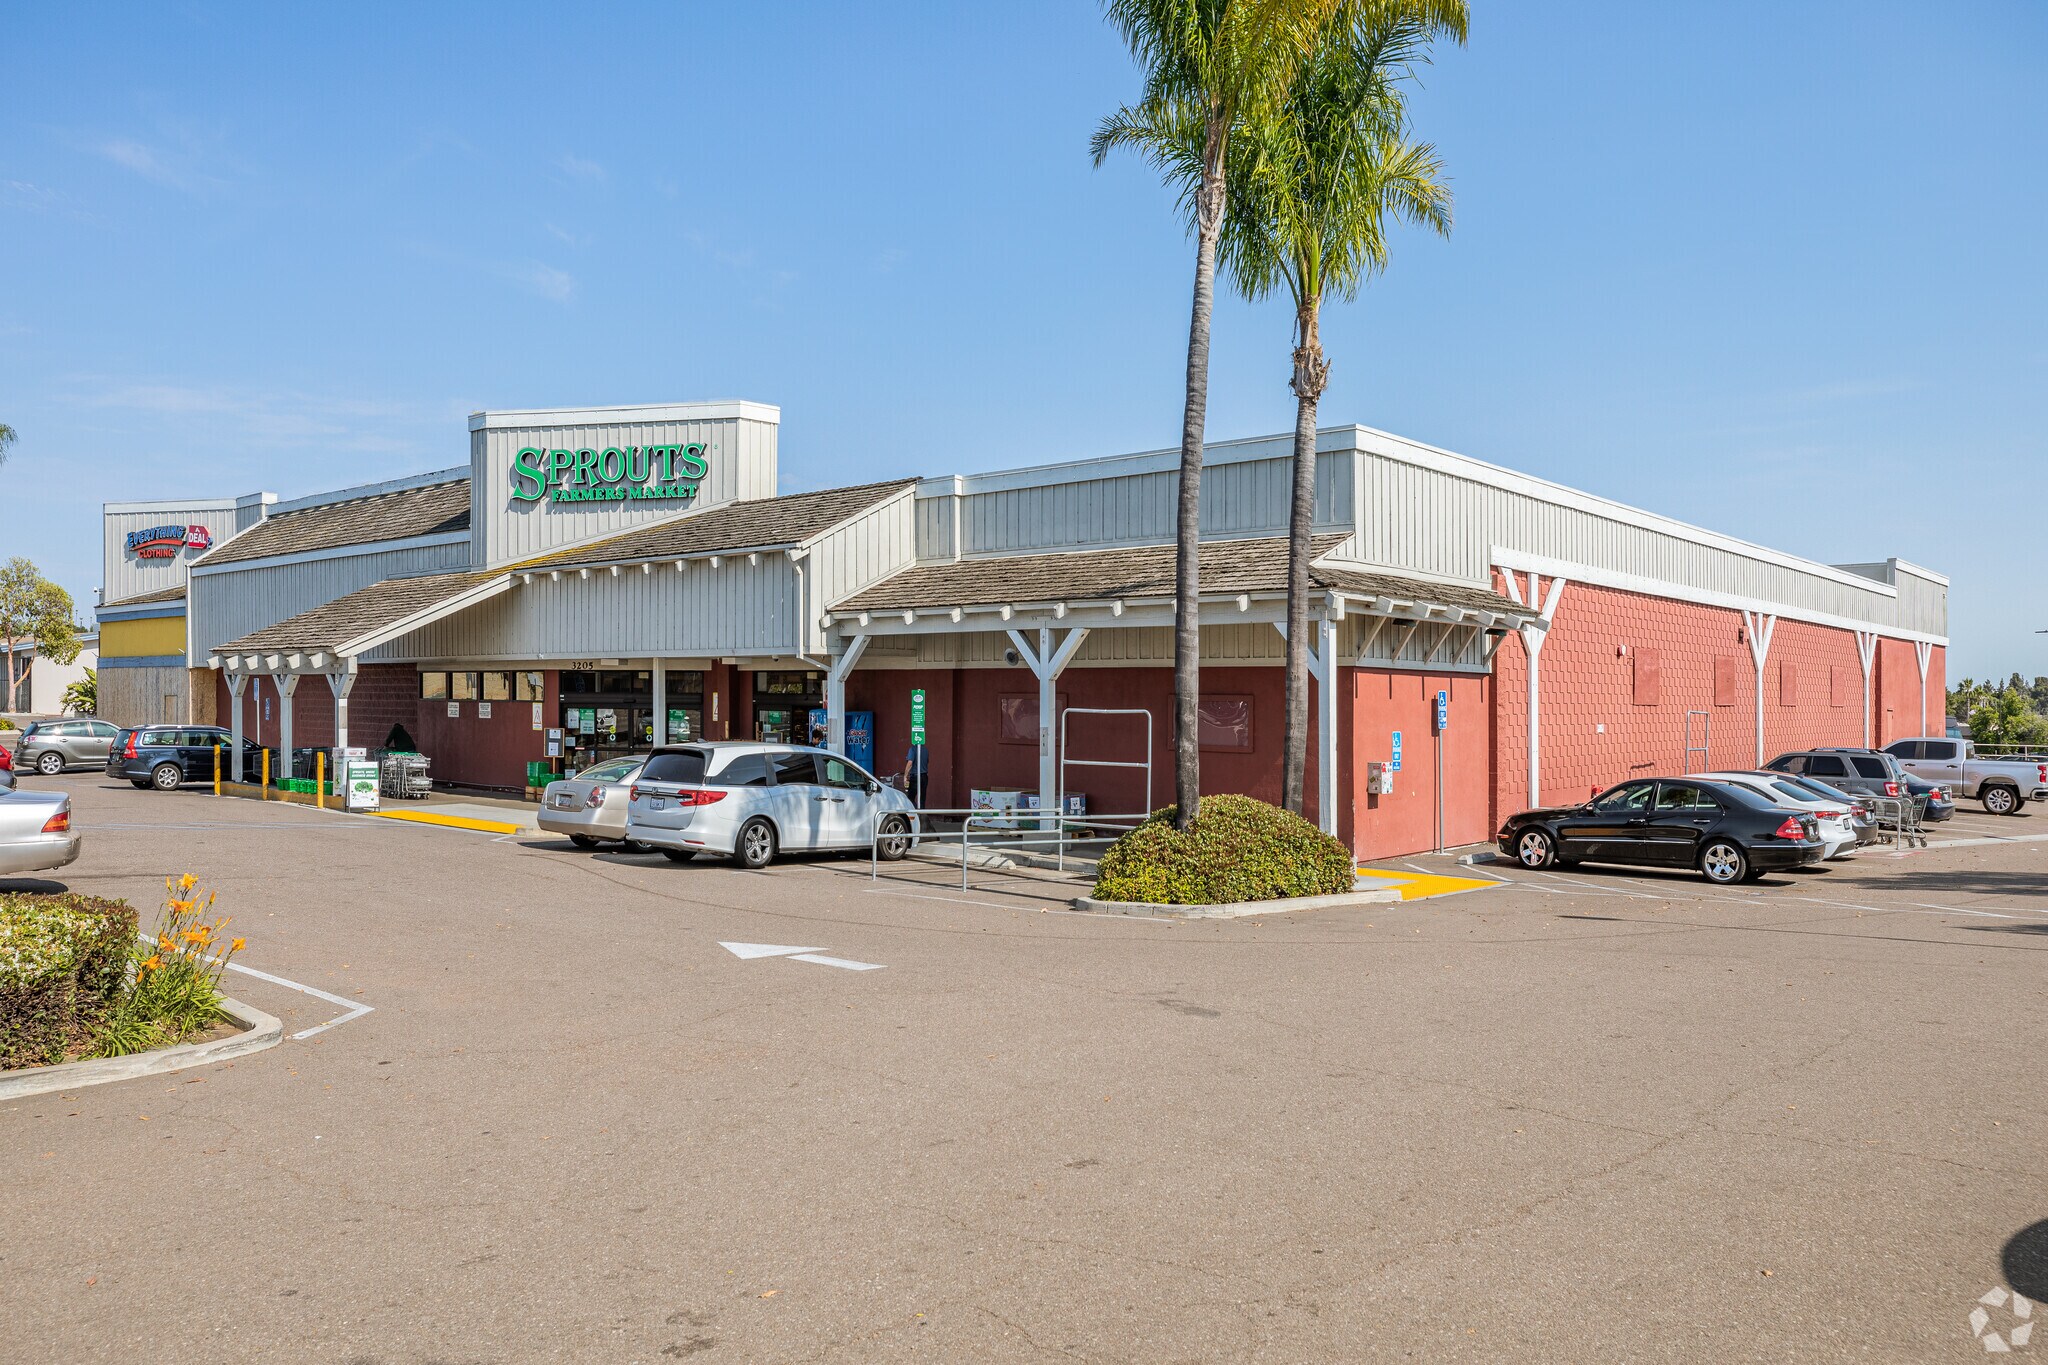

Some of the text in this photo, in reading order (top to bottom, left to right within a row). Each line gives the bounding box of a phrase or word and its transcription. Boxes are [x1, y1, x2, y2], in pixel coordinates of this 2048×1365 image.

[512, 442, 708, 502] SPROUTS
[551, 484, 698, 502] FARMERS MARKET
[127, 525, 185, 547] EVERYTHING
[188, 532, 207, 543] DEAL
[138, 548, 175, 558] CLOTHING
[571, 661, 594, 670] 3205
[847, 736, 870, 745] Water
